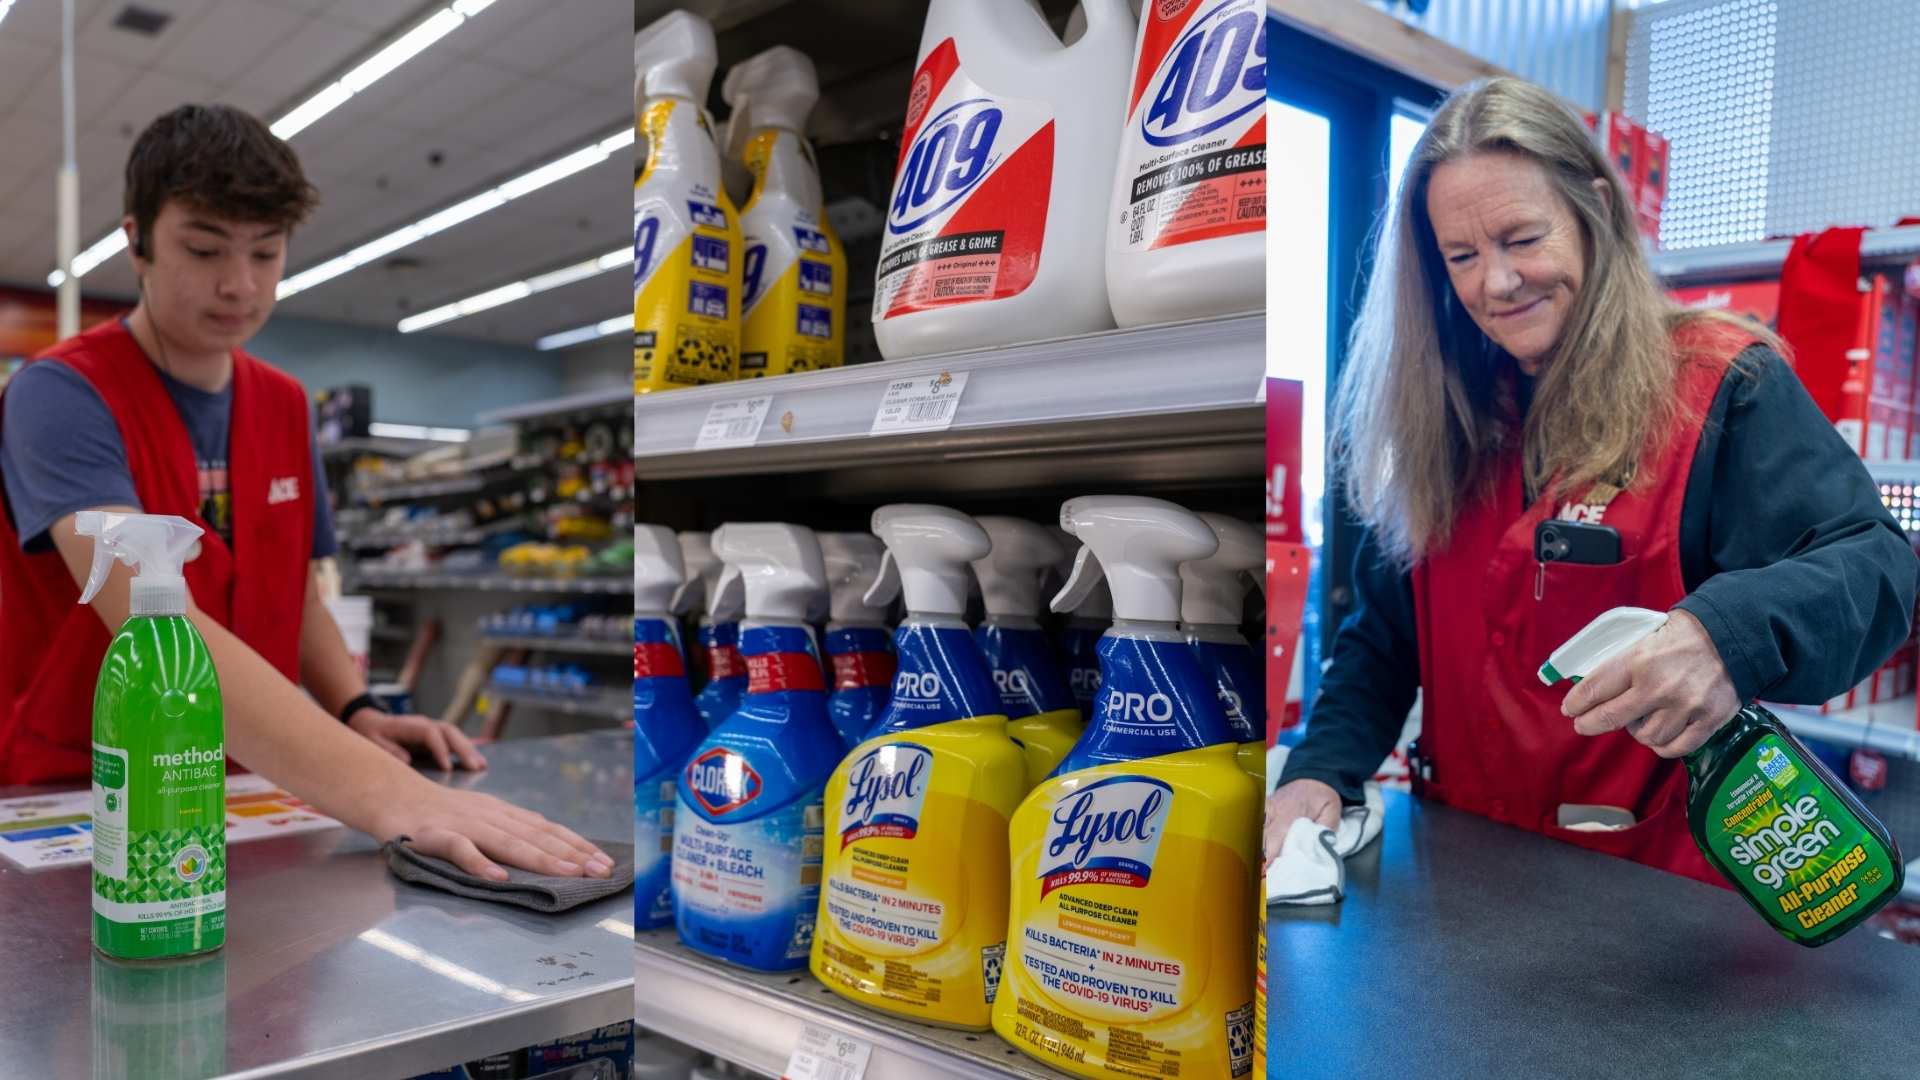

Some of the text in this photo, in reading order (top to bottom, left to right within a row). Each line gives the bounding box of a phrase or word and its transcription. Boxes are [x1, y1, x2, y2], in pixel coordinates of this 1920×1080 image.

[890, 108, 1003, 220] 409
[1140, 138, 1228, 172] Multi-Surface Cleaner
[1136, 168, 1174, 196] REMOVES
[1177, 161, 1205, 181] 100%
[1208, 158, 1222, 173] OF
[928, 239, 957, 256] GREASE
[959, 237, 966, 250] &
[968, 235, 998, 250] GRIME
[895, 671, 940, 698] PRO
[992, 669, 1029, 693] RO
[1106, 690, 1174, 722] PRO
[1102, 723, 1177, 737] COMMERCIAL USE
[152, 742, 223, 767] method
[1763, 753, 1785, 773] SAFER
[162, 765, 217, 782] ANTIBAC
[692, 764, 750, 799] CLORX
[846, 753, 925, 821] Lysol
[1723, 787, 1773, 828] Concentrated
[1049, 789, 1162, 866] Lysol
[1730, 795, 1820, 866] simple
[717, 859, 764, 880] BLEACH
[1752, 819, 1841, 890] green
[1050, 870, 1099, 888] KILLS 99.9%
[1779, 844, 1868, 913] All-Purpose
[881, 895, 890, 905] IN
[891, 897, 897, 907] 2
[898, 899, 941, 915] MINUTES
[1058, 893, 1139, 917] ADVANCED DEEP CLEAN
[1058, 902, 1138, 926] ALL PURPOSE CLEANER
[1797, 882, 1859, 929] Cleaner
[828, 902, 939, 941] TESTED AND PROVEN TO KILL
[839, 917, 852, 930] THE
[852, 922, 886, 941] COVID-19
[1025, 927, 1048, 944] KILLS
[1102, 951, 1114, 963] IN
[1115, 954, 1123, 965] 2
[1125, 956, 1181, 976] MINUTES
[1024, 954, 1177, 1005] TESTED AND PROVEN TO KILL
[1042, 974, 1061, 990] THE
[1062, 981, 1109, 1003] COVID-19
